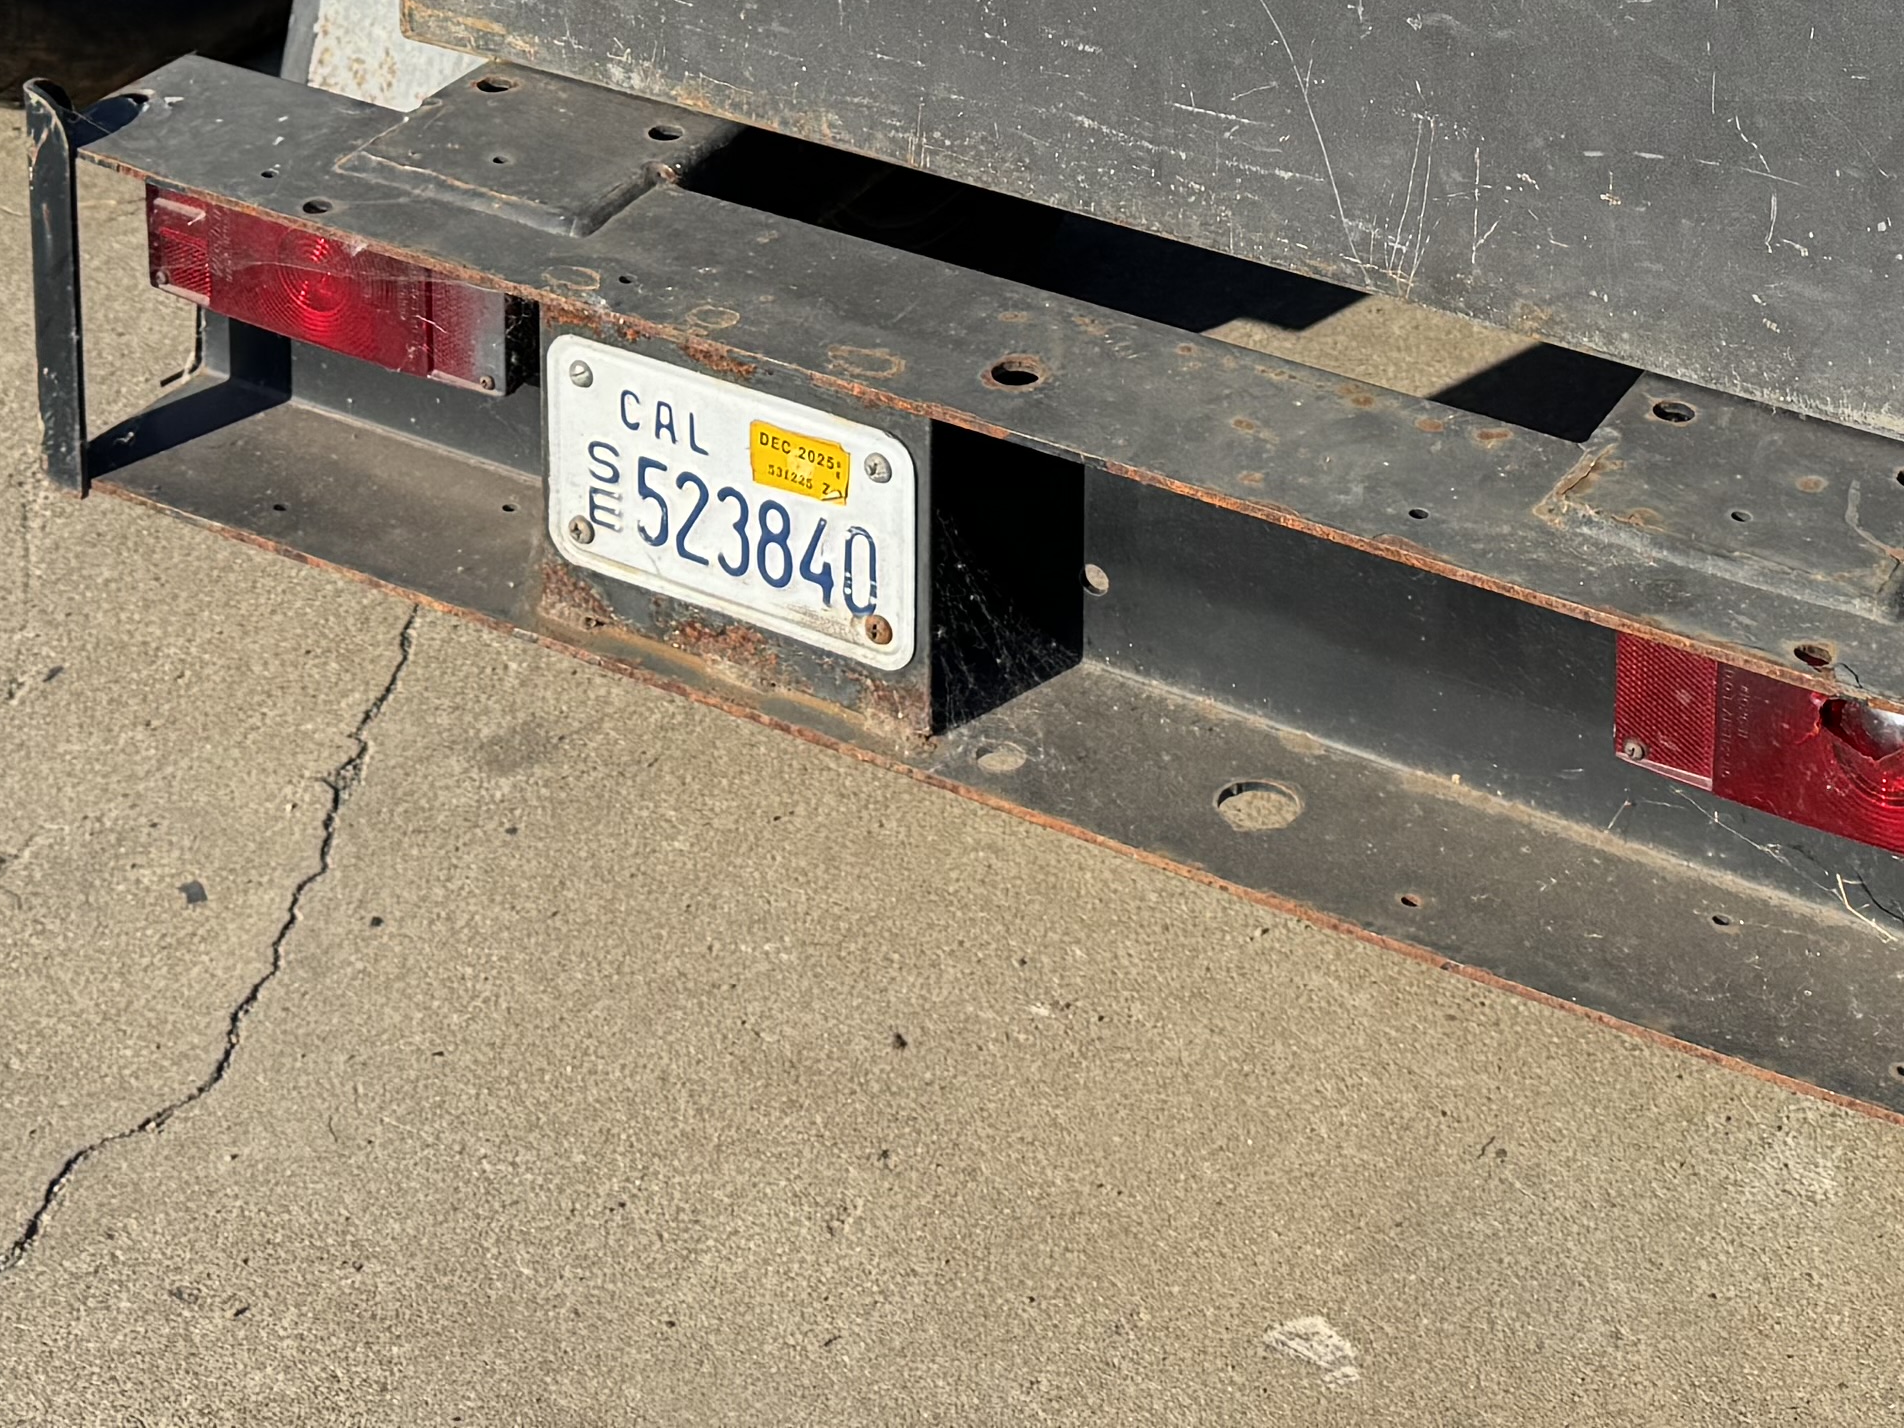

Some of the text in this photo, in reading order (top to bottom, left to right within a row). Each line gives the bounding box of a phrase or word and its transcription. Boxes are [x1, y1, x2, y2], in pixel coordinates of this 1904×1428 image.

[619, 389, 710, 456] CAL
[759, 431, 835, 470] DEC 2025
[637, 455, 878, 617] 523840
